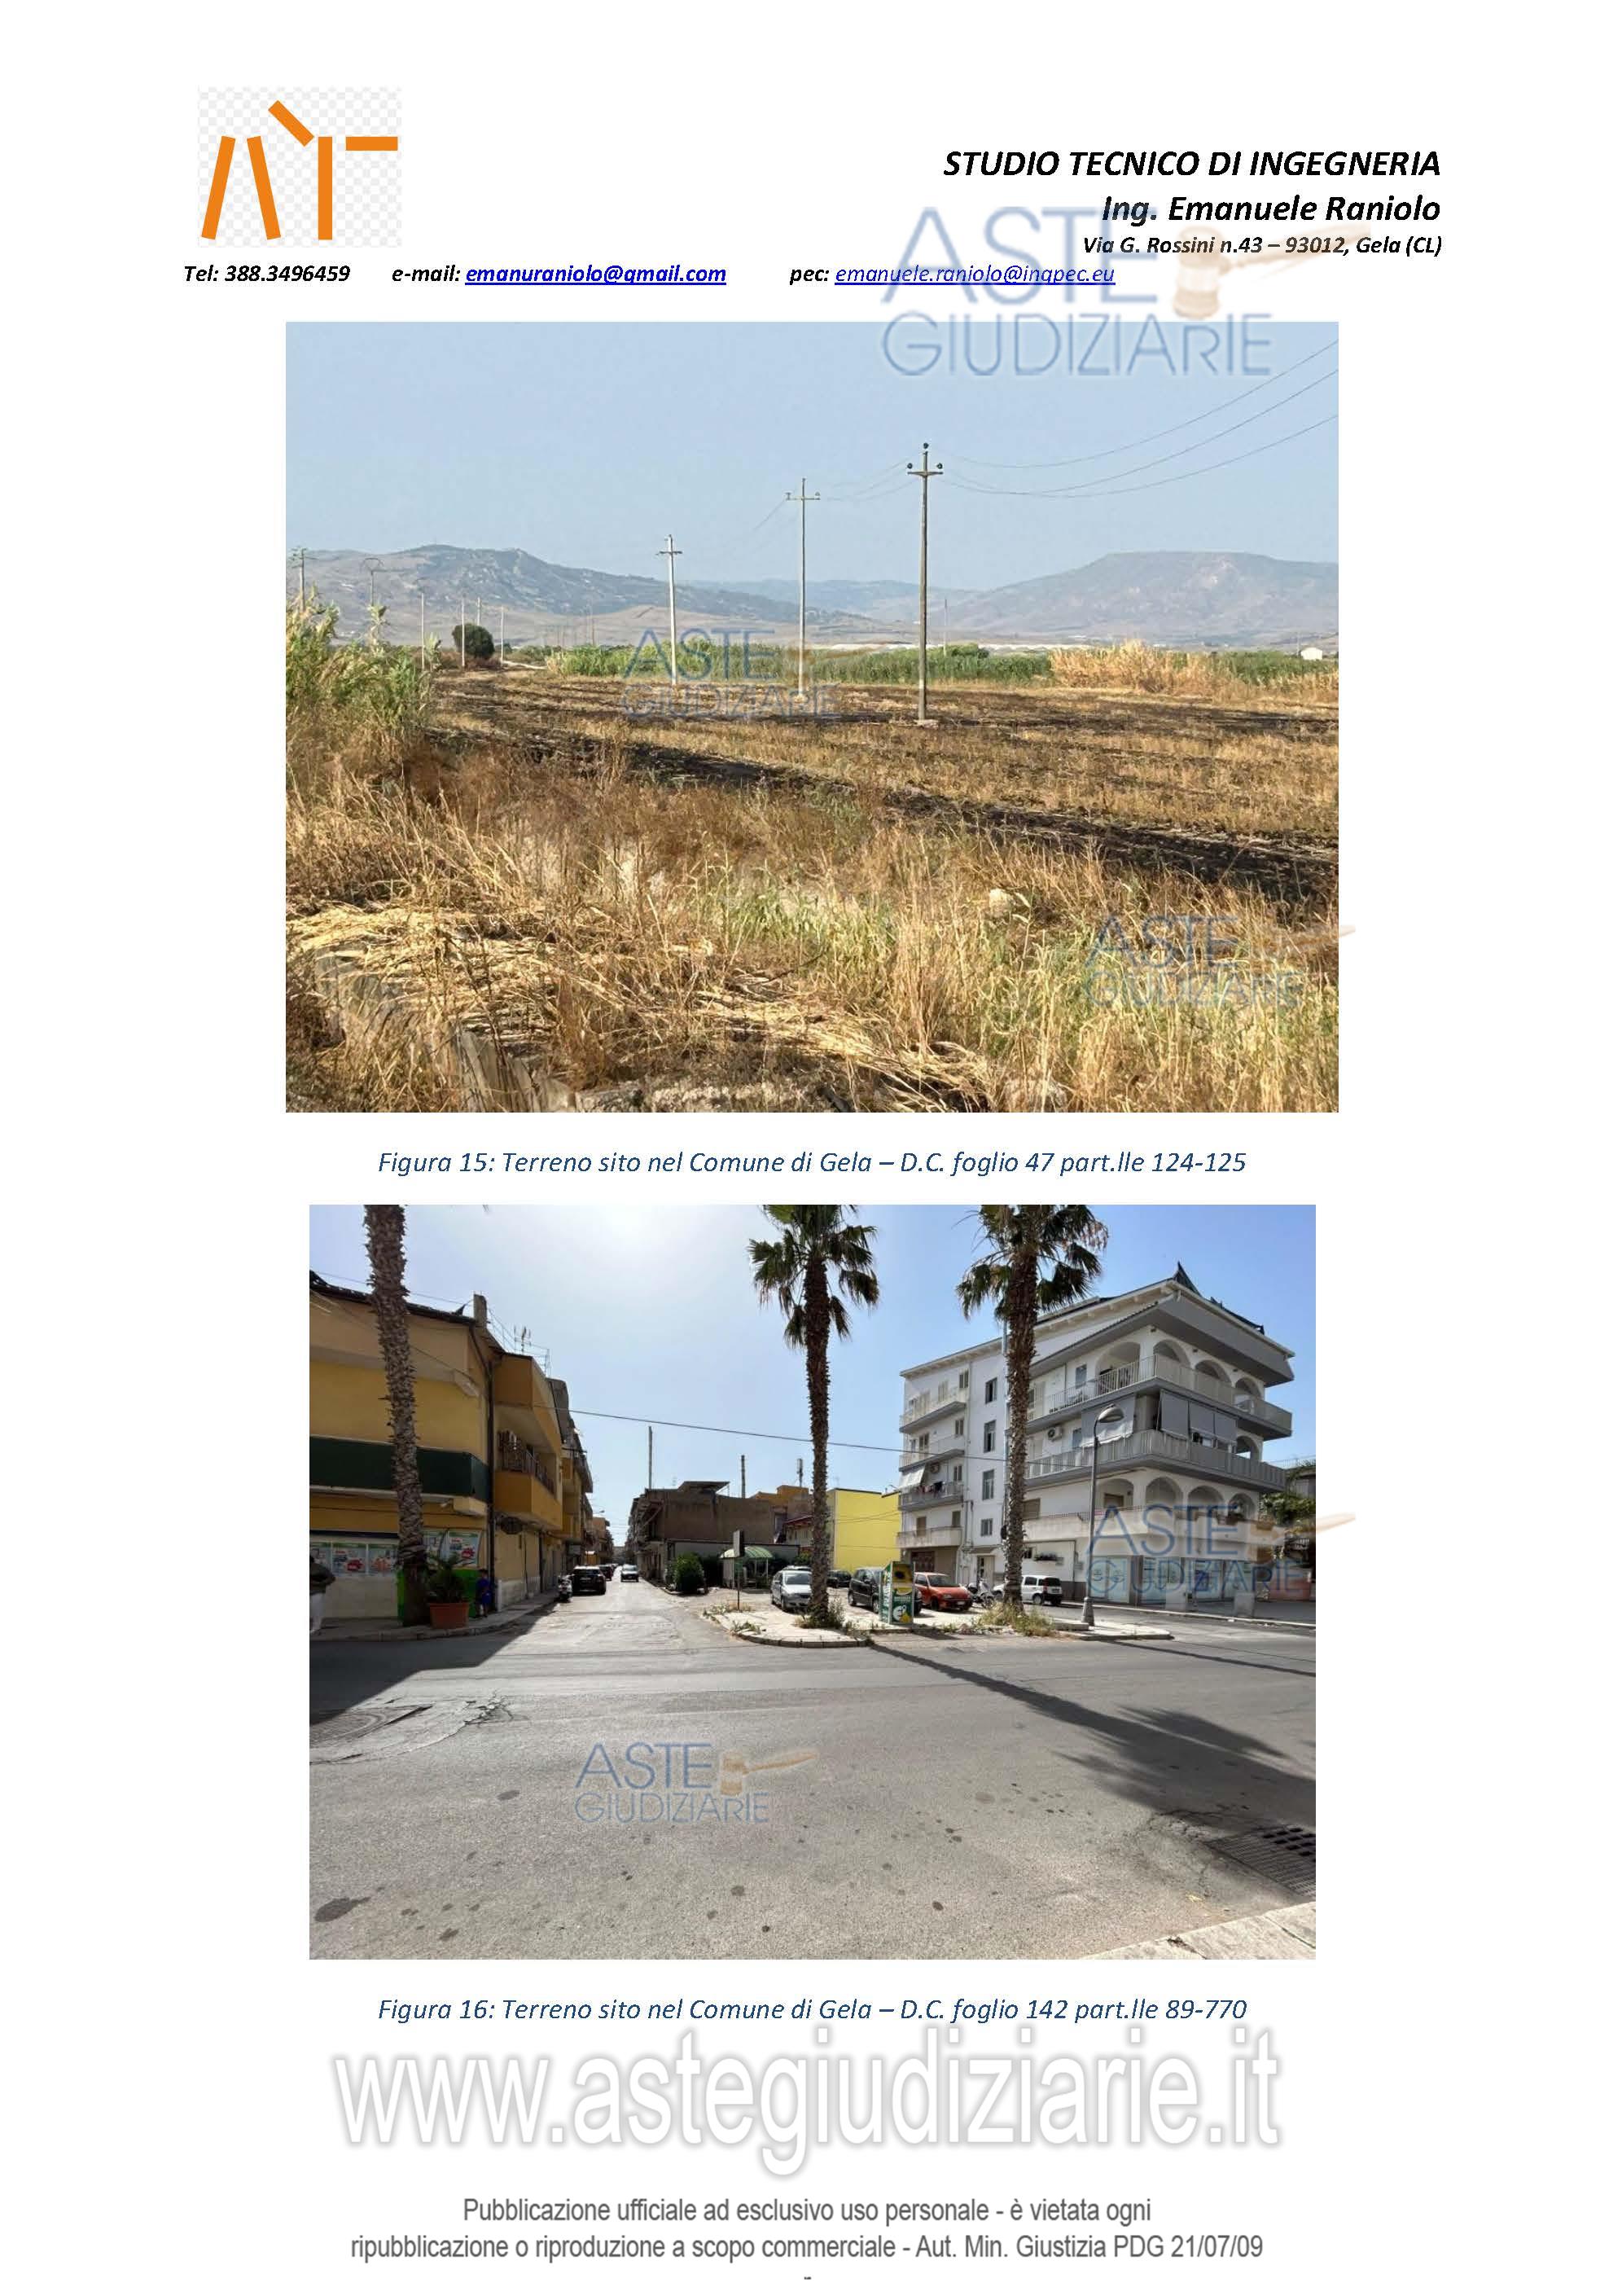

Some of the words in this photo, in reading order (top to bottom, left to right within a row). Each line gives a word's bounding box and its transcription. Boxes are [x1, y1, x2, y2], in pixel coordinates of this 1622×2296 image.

[943, 151, 1060, 176] STUDIO
[1069, 151, 1200, 176] TECNICO
[1208, 151, 1242, 176] DI
[1249, 151, 1440, 176] INGEGNERIA
[1102, 195, 1157, 227] Ing.
[1168, 194, 1317, 221] Emanuele
[1325, 194, 1440, 221] Raniolo
[1084, 236, 1115, 253] Via
[1120, 236, 1140, 253] G.
[1146, 236, 1216, 253] Rossini
[1220, 236, 1263, 253] n.43
[1285, 236, 1349, 257] 93012,
[1356, 235, 1401, 253] Gela
[1405, 235, 1442, 257] (CL)
[184, 264, 219, 282] Tel:
[224, 265, 351, 282] 388.3496459
[392, 264, 461, 282] e-mail:
[465, 264, 727, 285] emanuraniolo@gmail.com
[789, 269, 829, 286] pec:
[835, 264, 1116, 285] emanuele.raniolo@ingpec.eu
[378, 1152, 452, 1177] Figura
[459, 1152, 495, 1172] 15:
[502, 1152, 592, 1172] Terreno
[598, 1152, 641, 1172] sito
[647, 1151, 683, 1172] nel
[690, 1152, 785, 1172] Comune
[791, 1151, 813, 1172] di
[820, 1151, 872, 1172] Gela
[901, 1152, 944, 1172] D.C.
[949, 1151, 1019, 1177] foglio
[1024, 1152, 1055, 1172] 47
[1059, 1151, 1145, 1177] part.lle
[1151, 1152, 1247, 1172] 124-125
[378, 1999, 452, 2024] Figura
[459, 2000, 495, 2019] 16:
[502, 2000, 592, 2019] Terreno
[598, 1999, 641, 2019] sito
[647, 1998, 683, 2019] nel
[690, 2000, 785, 2019] Comune
[791, 1998, 813, 2019] di
[819, 1998, 872, 2019] Gela
[901, 2000, 944, 2019] D.C.
[949, 1998, 1019, 2024] foglio
[1026, 2000, 1068, 2019] 142
[1074, 1998, 1159, 2024] part.lle
[1165, 2000, 1247, 2019] 89-770
